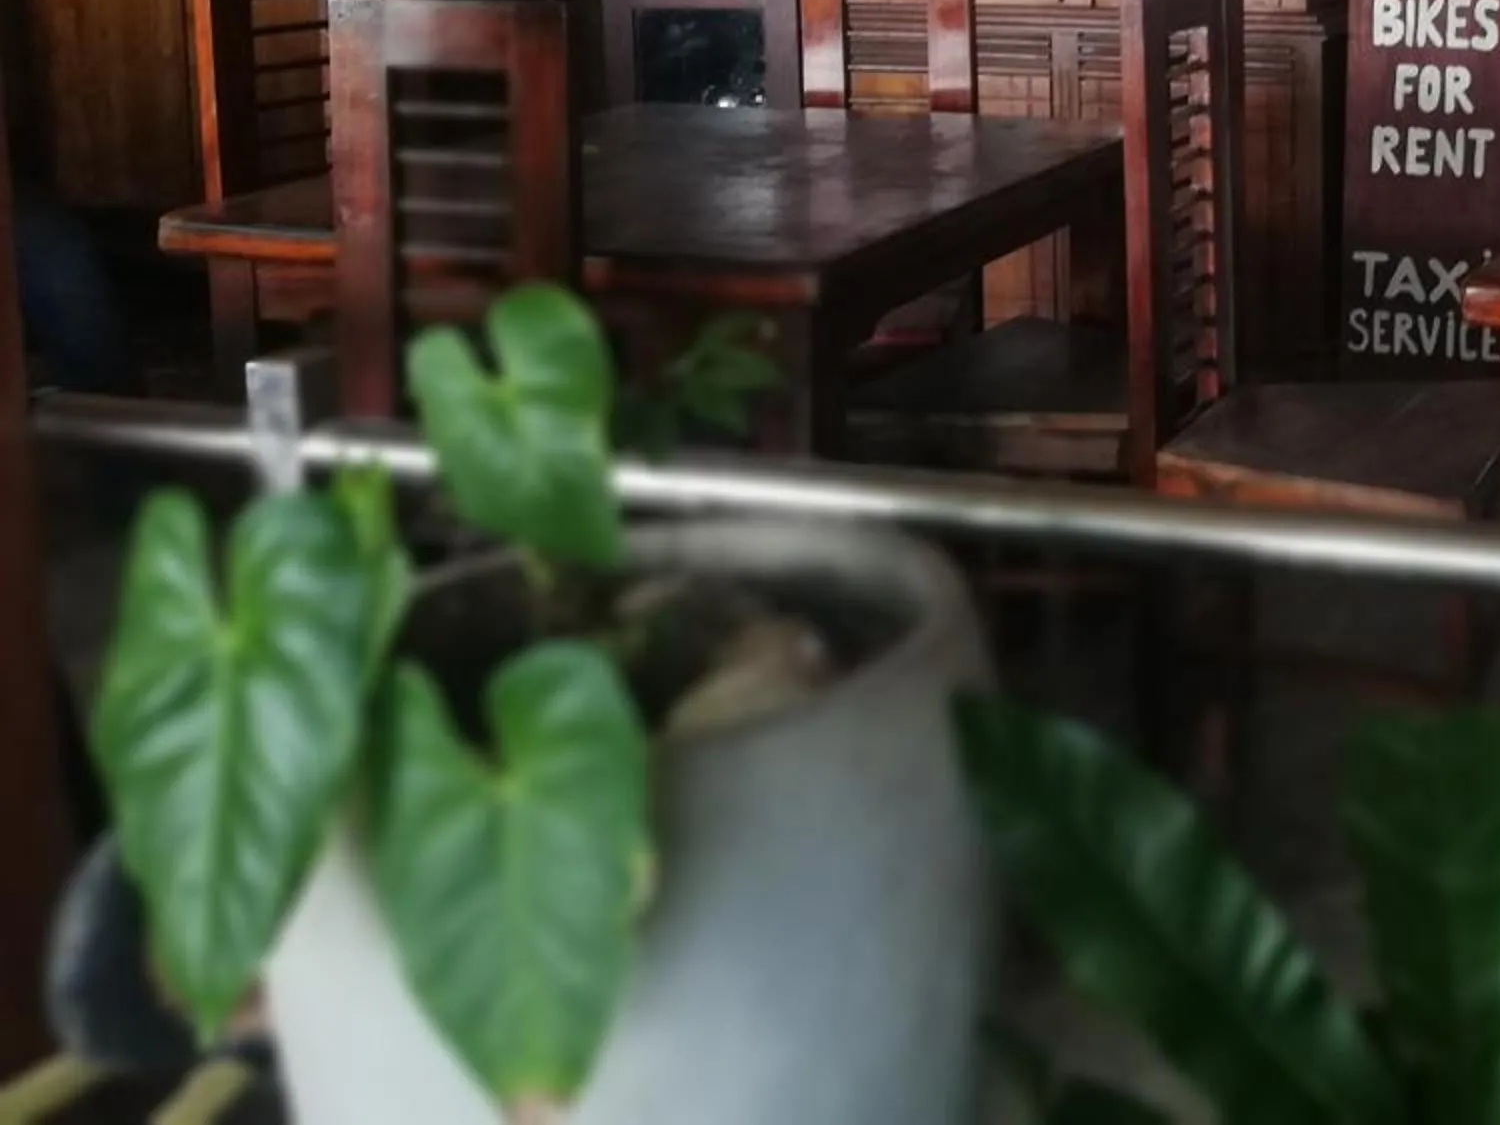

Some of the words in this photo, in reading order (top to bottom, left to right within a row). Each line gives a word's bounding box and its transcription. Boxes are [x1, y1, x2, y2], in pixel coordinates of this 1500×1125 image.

[1393, 64, 1474, 115] FOR
[1371, 125, 1495, 179] RENT
[1352, 249, 1493, 305] TAX
